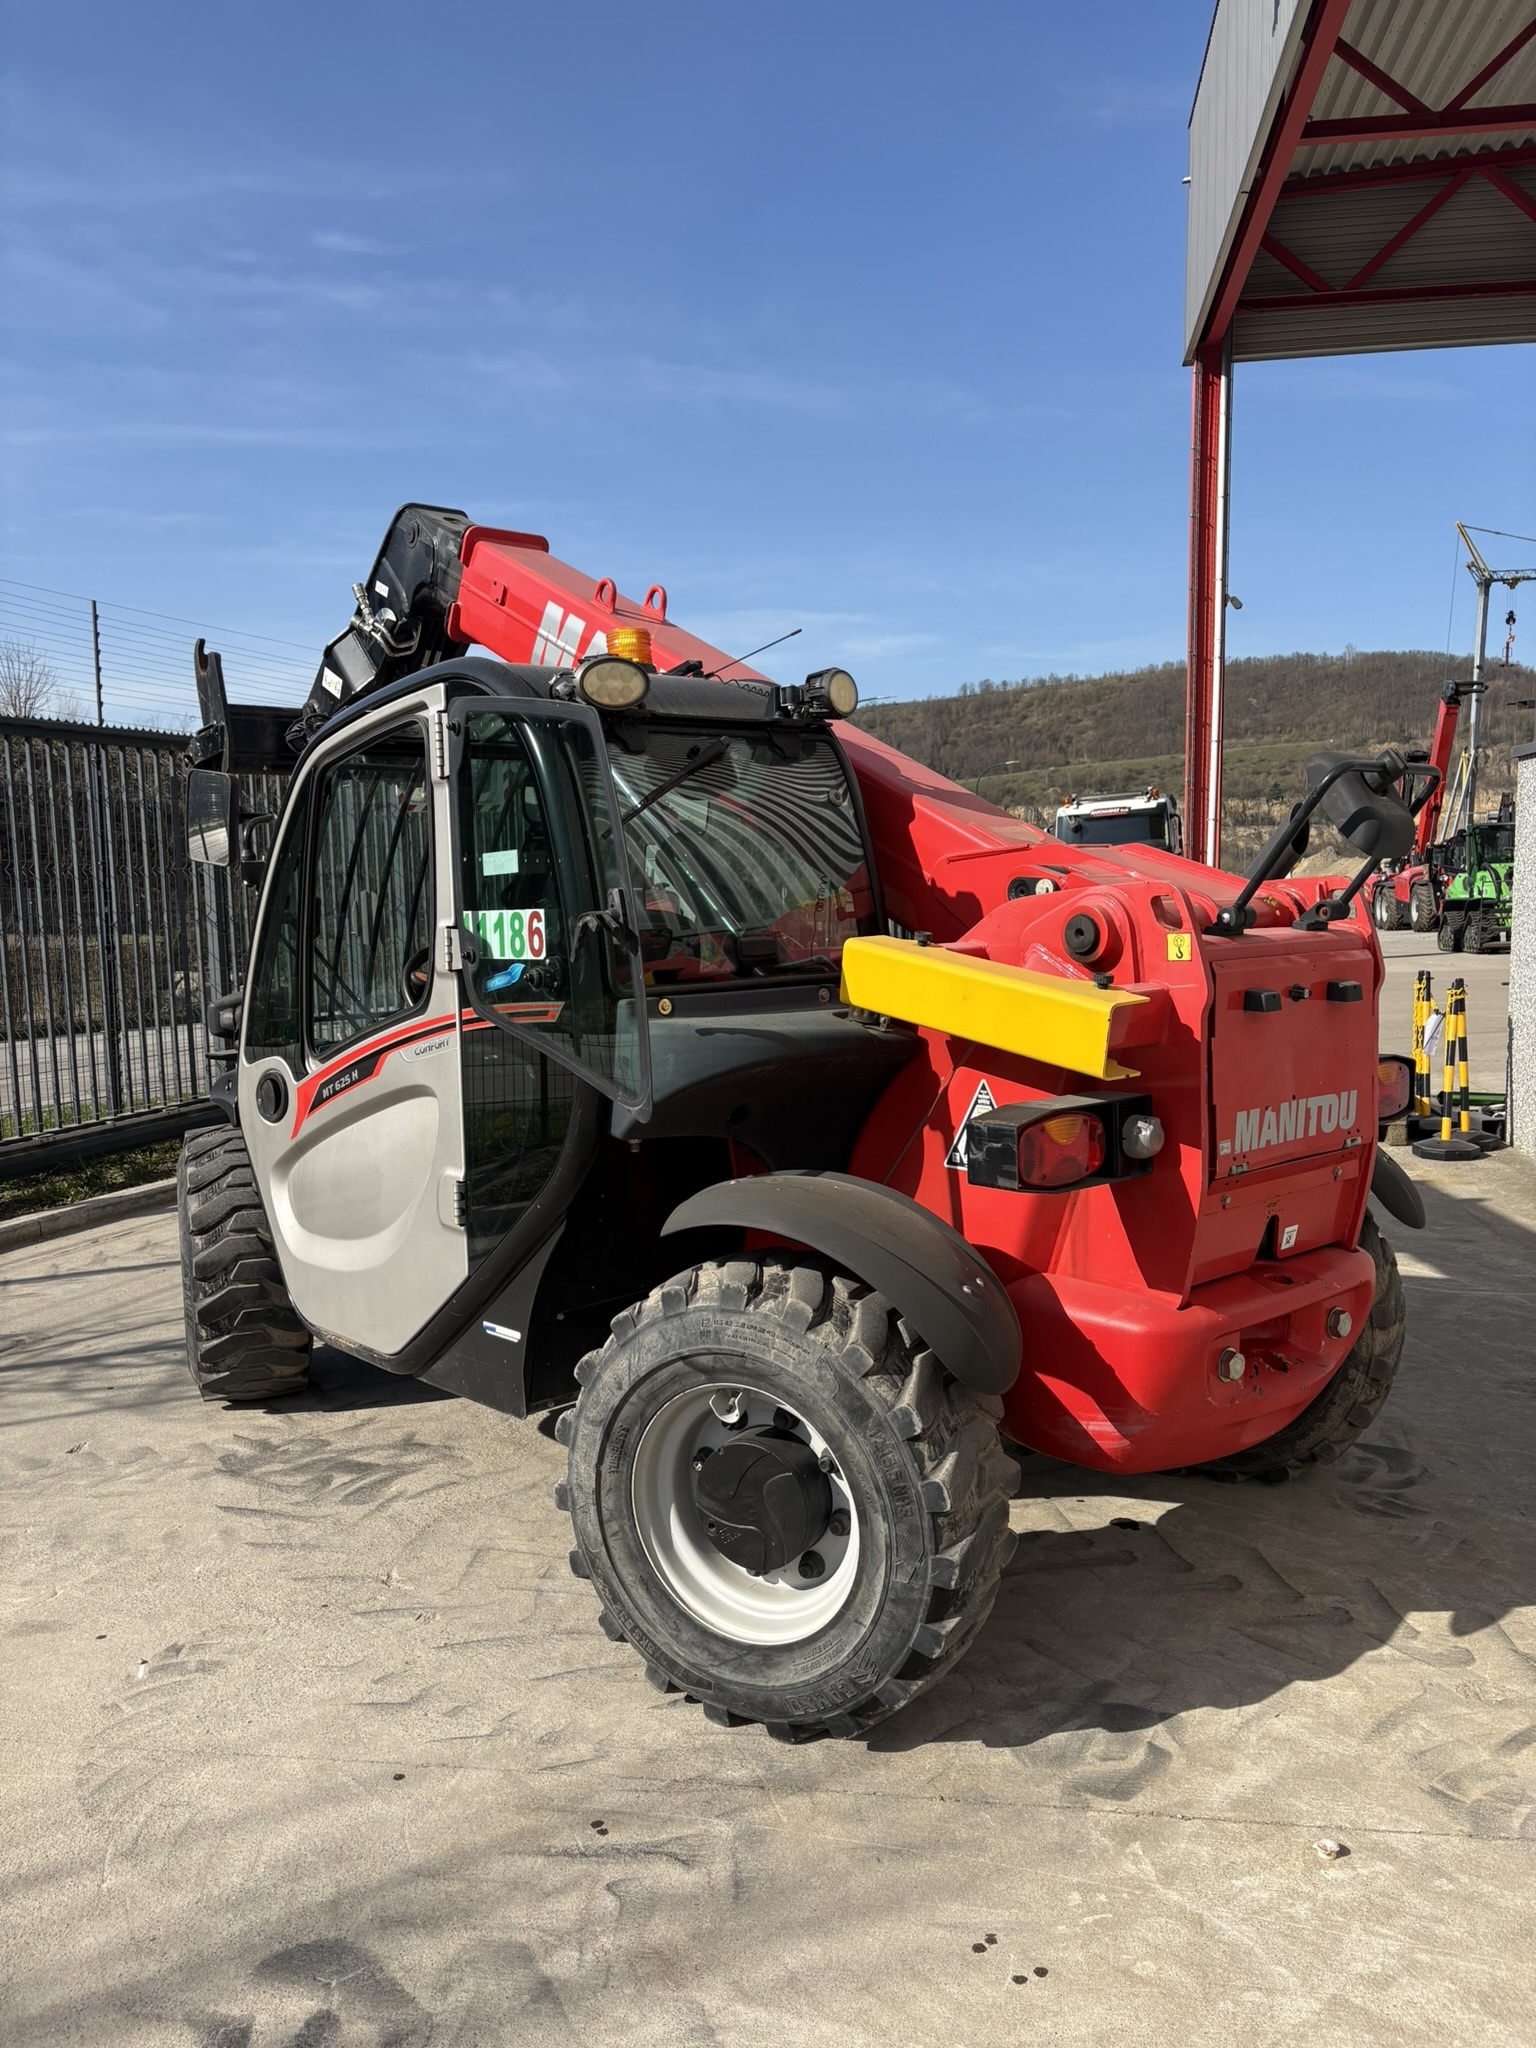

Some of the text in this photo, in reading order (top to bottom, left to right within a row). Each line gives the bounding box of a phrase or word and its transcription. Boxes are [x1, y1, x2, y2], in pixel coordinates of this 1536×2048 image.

[322, 1069, 358, 1098] MT 625 H
[1234, 1089, 1358, 1155] MANITOU
[785, 1678, 858, 1716] CAMSO
